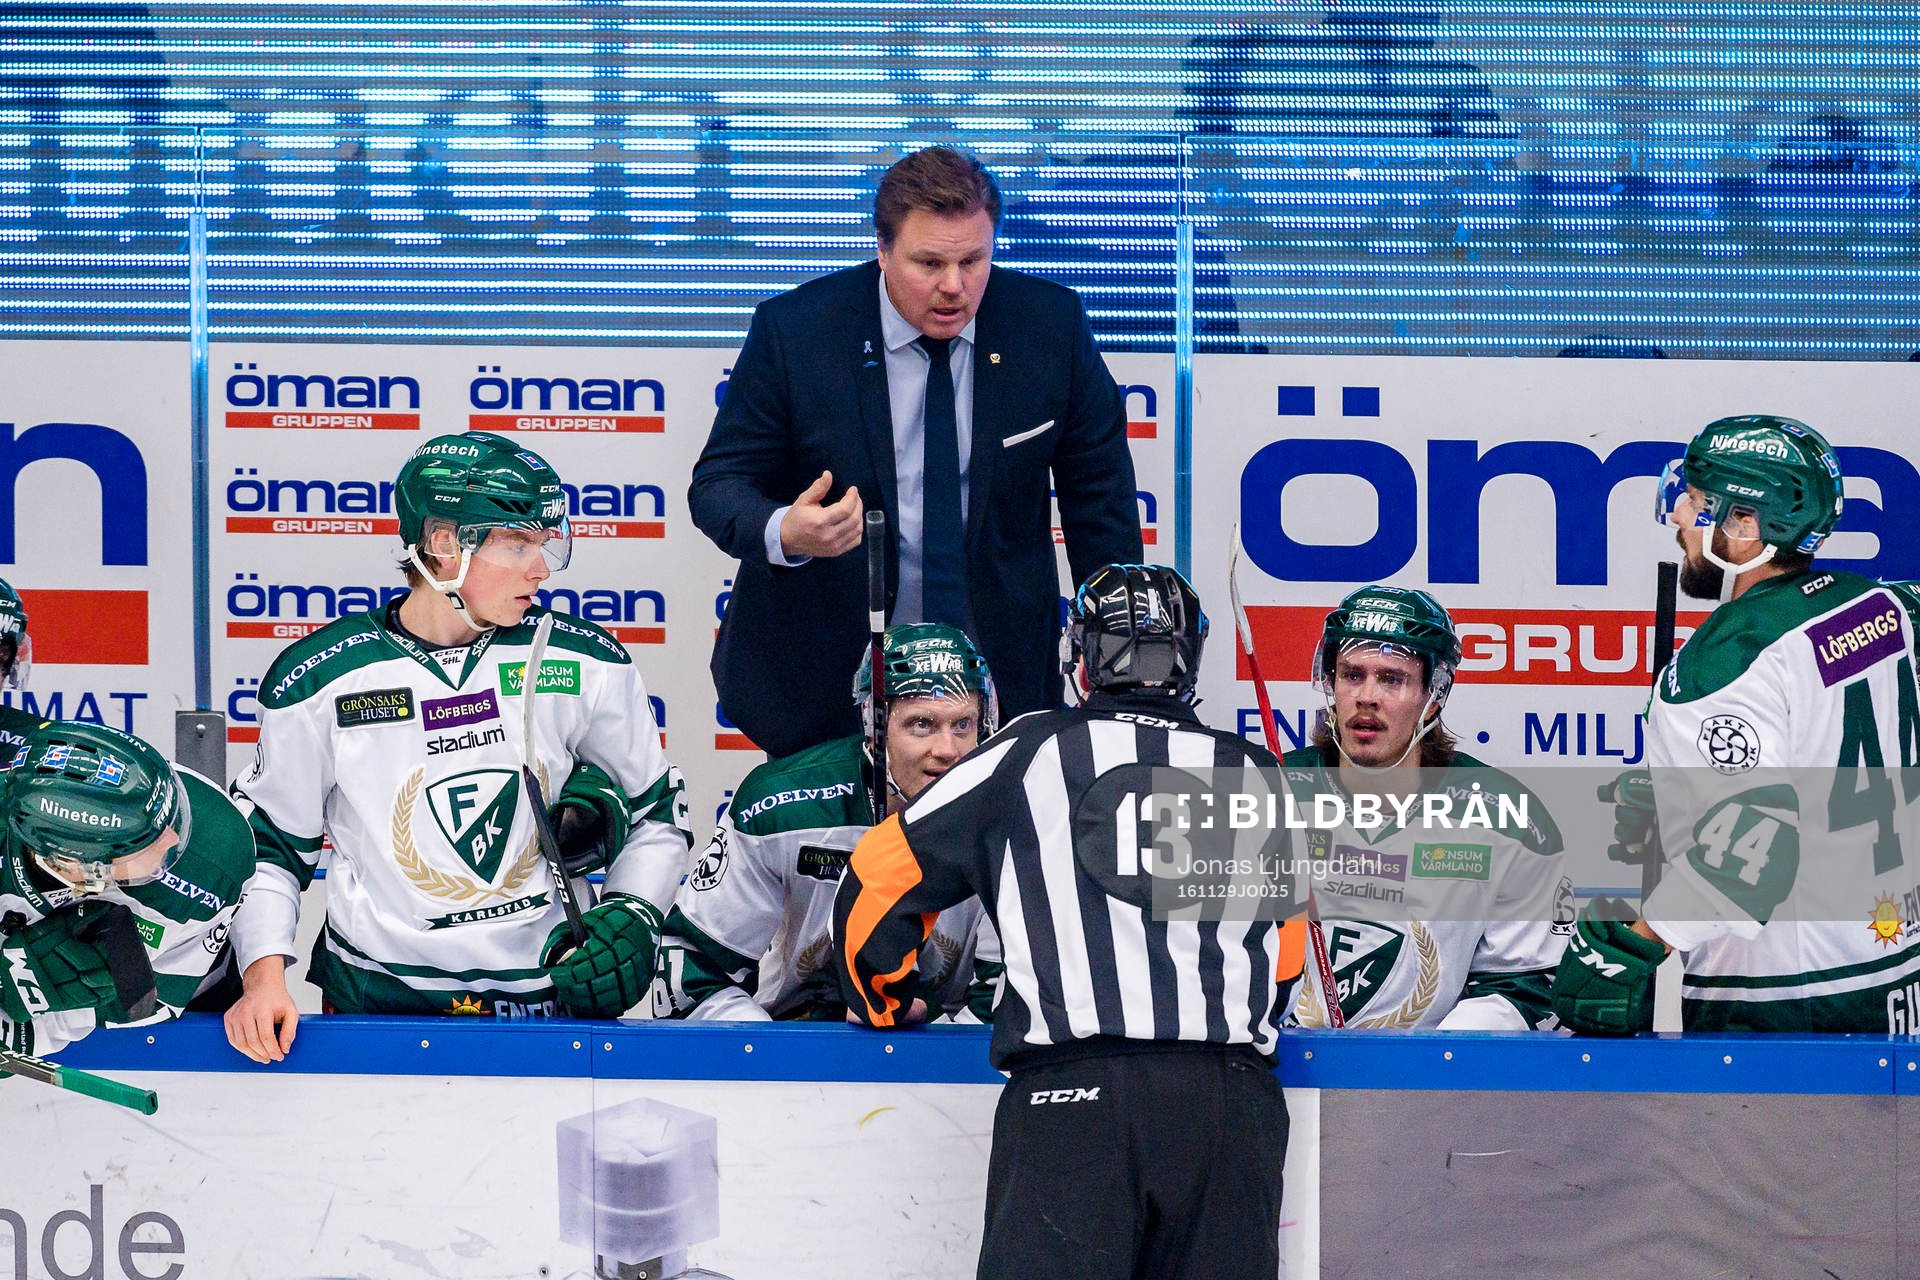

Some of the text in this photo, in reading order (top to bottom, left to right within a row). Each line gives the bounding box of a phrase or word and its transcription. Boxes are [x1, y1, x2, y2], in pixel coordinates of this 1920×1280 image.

[226, 363, 420, 408] öman
[470, 365, 665, 411] öman
[272, 415, 373, 428] GRUPPEN
[516, 418, 617, 431] GRUPPEN
[1709, 434, 1788, 459] Ninetech
[434, 494, 461, 503] CCM
[1726, 484, 1765, 498] CCM
[272, 520, 373, 533] GRUPPEN
[1802, 574, 1834, 595] CCM
[1819, 610, 1898, 665] LÖFBERGS
[272, 630, 382, 700] MOELVEN
[442, 657, 461, 666] SHL
[508, 676, 574, 689] VÄMLAND
[341, 692, 407, 712] GRÖNSAKS
[360, 707, 398, 720] HUSET
[429, 698, 491, 721] LÖFBERGS
[1114, 712, 1180, 729] CCM
[427, 724, 506, 756] stadium
[40, 798, 122, 828] Ninetech
[739, 782, 855, 824] MOELVEN
[1116, 792, 1193, 880] 13
[1698, 802, 1780, 886] 44
[1420, 861, 1483, 873] VÄRMLAND
[12, 856, 43, 908] stadium
[161, 871, 226, 911] ELVEN
[1323, 880, 1405, 904] stadium
[451, 898, 531, 924] KARLSTAD
[1030, 1087, 1100, 1105] CCM
